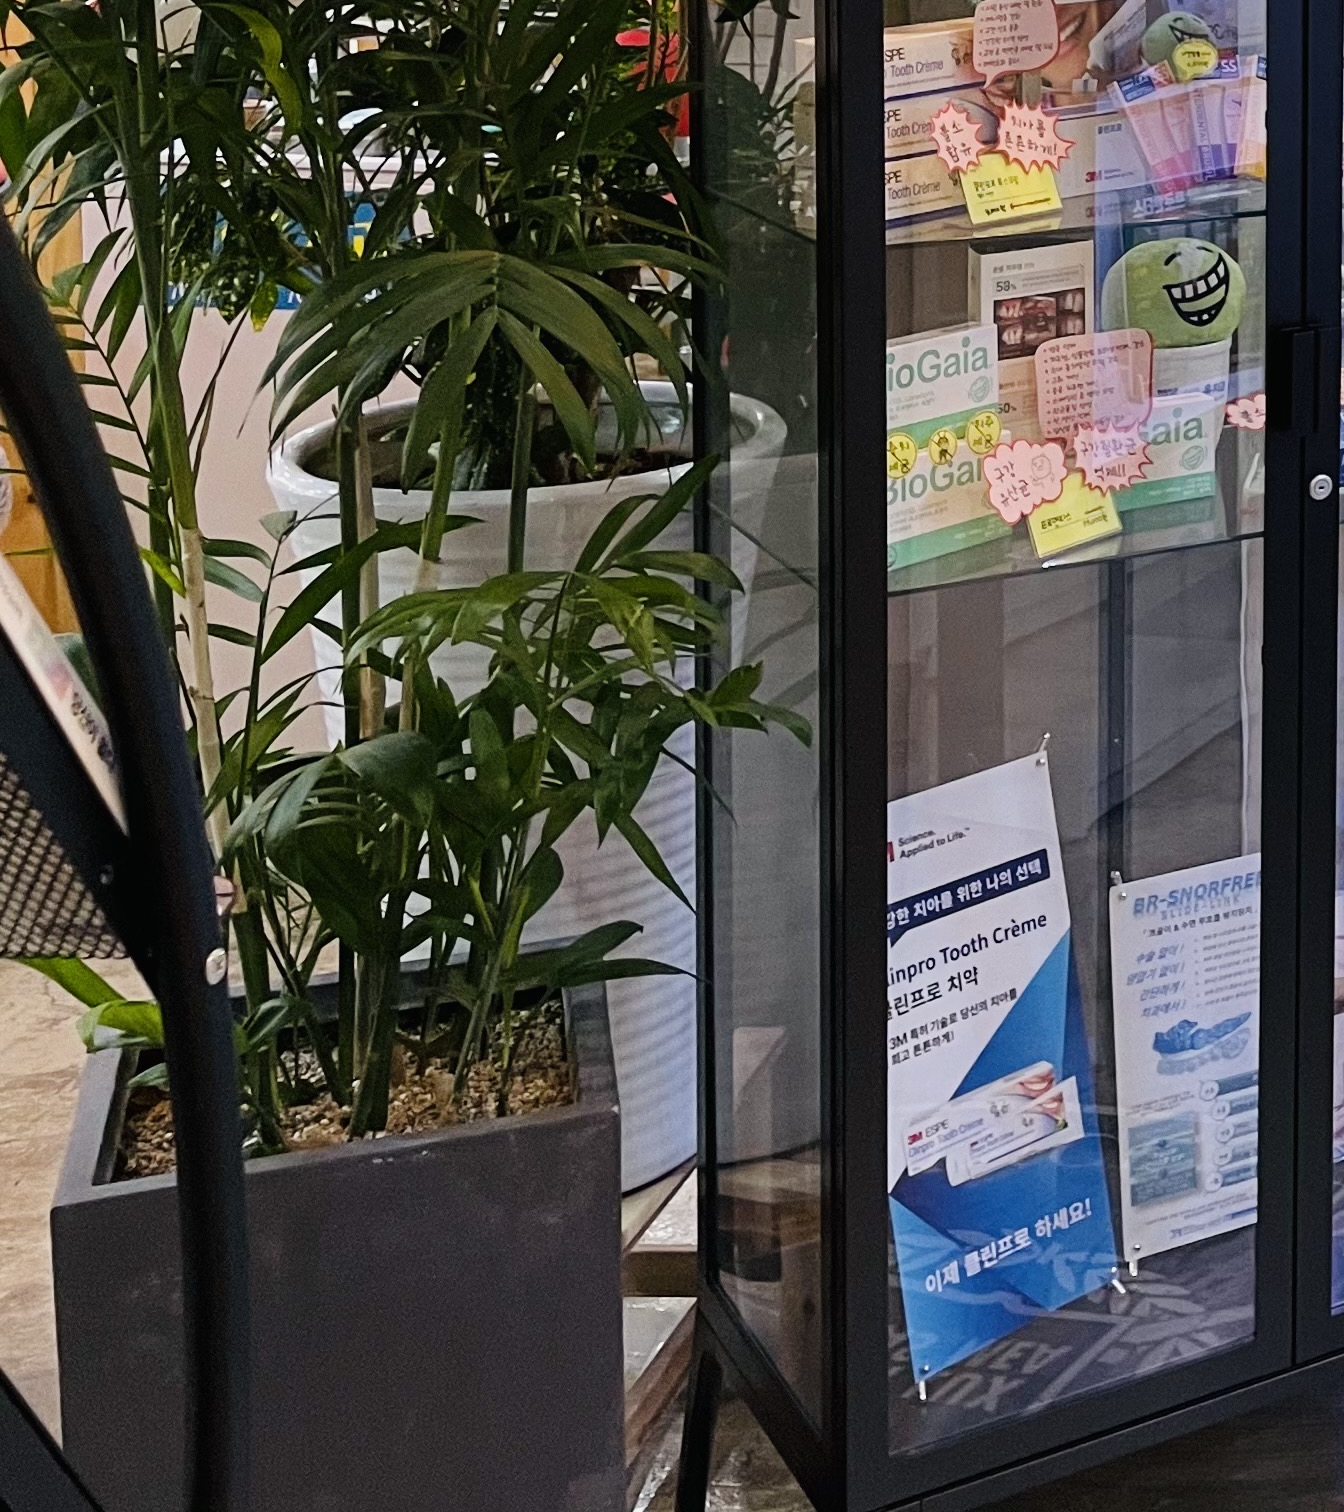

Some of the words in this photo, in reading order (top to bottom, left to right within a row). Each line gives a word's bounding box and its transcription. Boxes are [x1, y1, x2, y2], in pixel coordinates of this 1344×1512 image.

[887, 336, 989, 392] ioGaia
[899, 840, 934, 860] Applied
[936, 838, 945, 847] to
[913, 891, 953, 917] 치아를
[957, 879, 983, 903] 위한
[986, 869, 1012, 891] 나의
[1015, 858, 1042, 881] 선택
[939, 933, 989, 965] Tooth
[992, 914, 1047, 944] Crème
[948, 966, 979, 992] 치약
[889, 1034, 908, 1051] 3M
[909, 1021, 929, 1040] 특허
[930, 1010, 959, 1031] 기술로
[960, 1000, 989, 1021] 당신의
[990, 987, 1018, 1009] 치아를
[925, 1259, 960, 1293] 이제
[964, 1226, 1032, 1278] 클린프로
[1034, 1197, 1092, 1239] 하세요!
